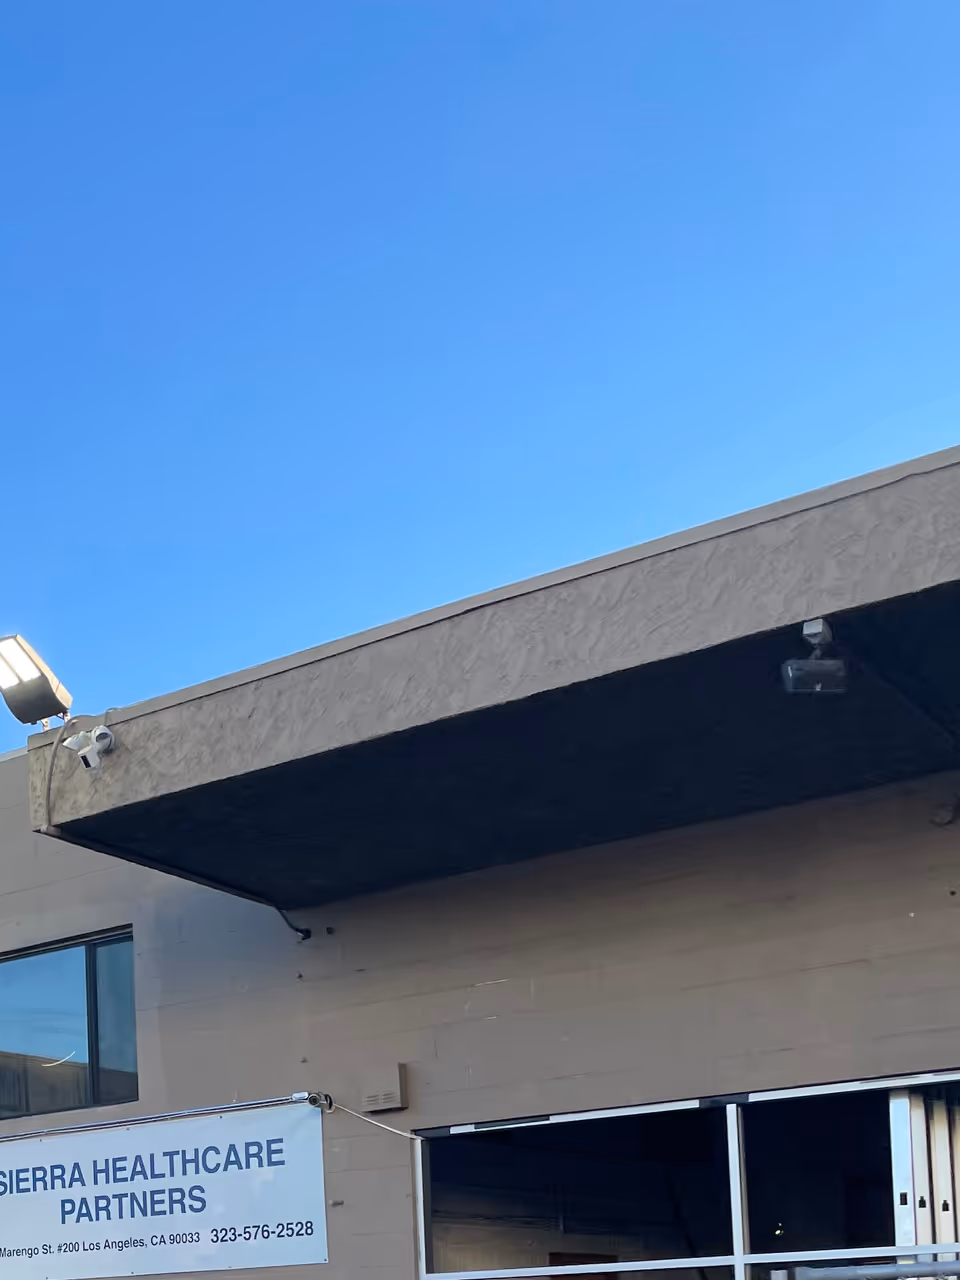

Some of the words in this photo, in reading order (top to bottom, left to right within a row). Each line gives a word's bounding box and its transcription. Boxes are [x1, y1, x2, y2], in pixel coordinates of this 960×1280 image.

[93, 1138, 286, 1186] HEALTHCARE
[60, 1185, 207, 1224] PARTNERS
[41, 1242, 55, 1254] St.
[57, 1241, 80, 1253] #200
[82, 1239, 101, 1252] Los
[103, 1235, 148, 1252] Angeles,
[150, 1233, 167, 1246] CA
[168, 1231, 200, 1245] 90033
[210, 1221, 314, 1244] 323-576-2528
